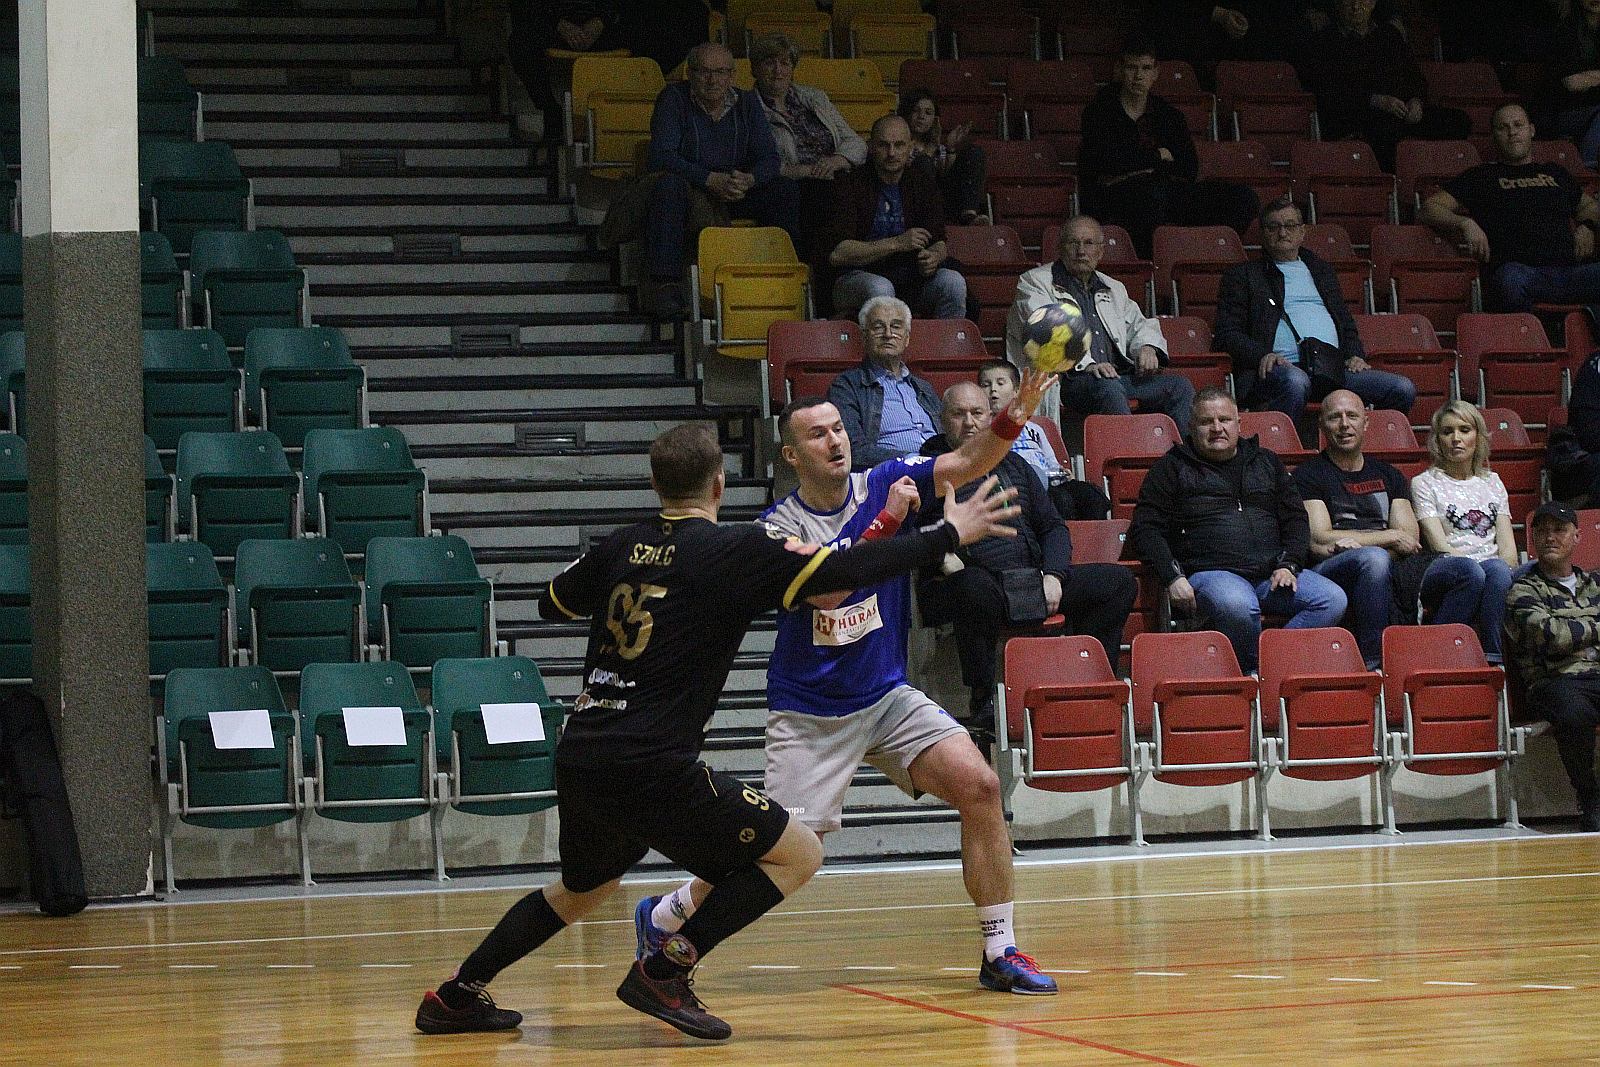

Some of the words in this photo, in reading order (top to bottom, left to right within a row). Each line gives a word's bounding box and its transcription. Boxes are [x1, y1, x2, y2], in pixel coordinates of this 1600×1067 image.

[629, 543, 676, 566] SZULC
[838, 604, 876, 629] HURAS
[785, 807, 804, 816] mpa
